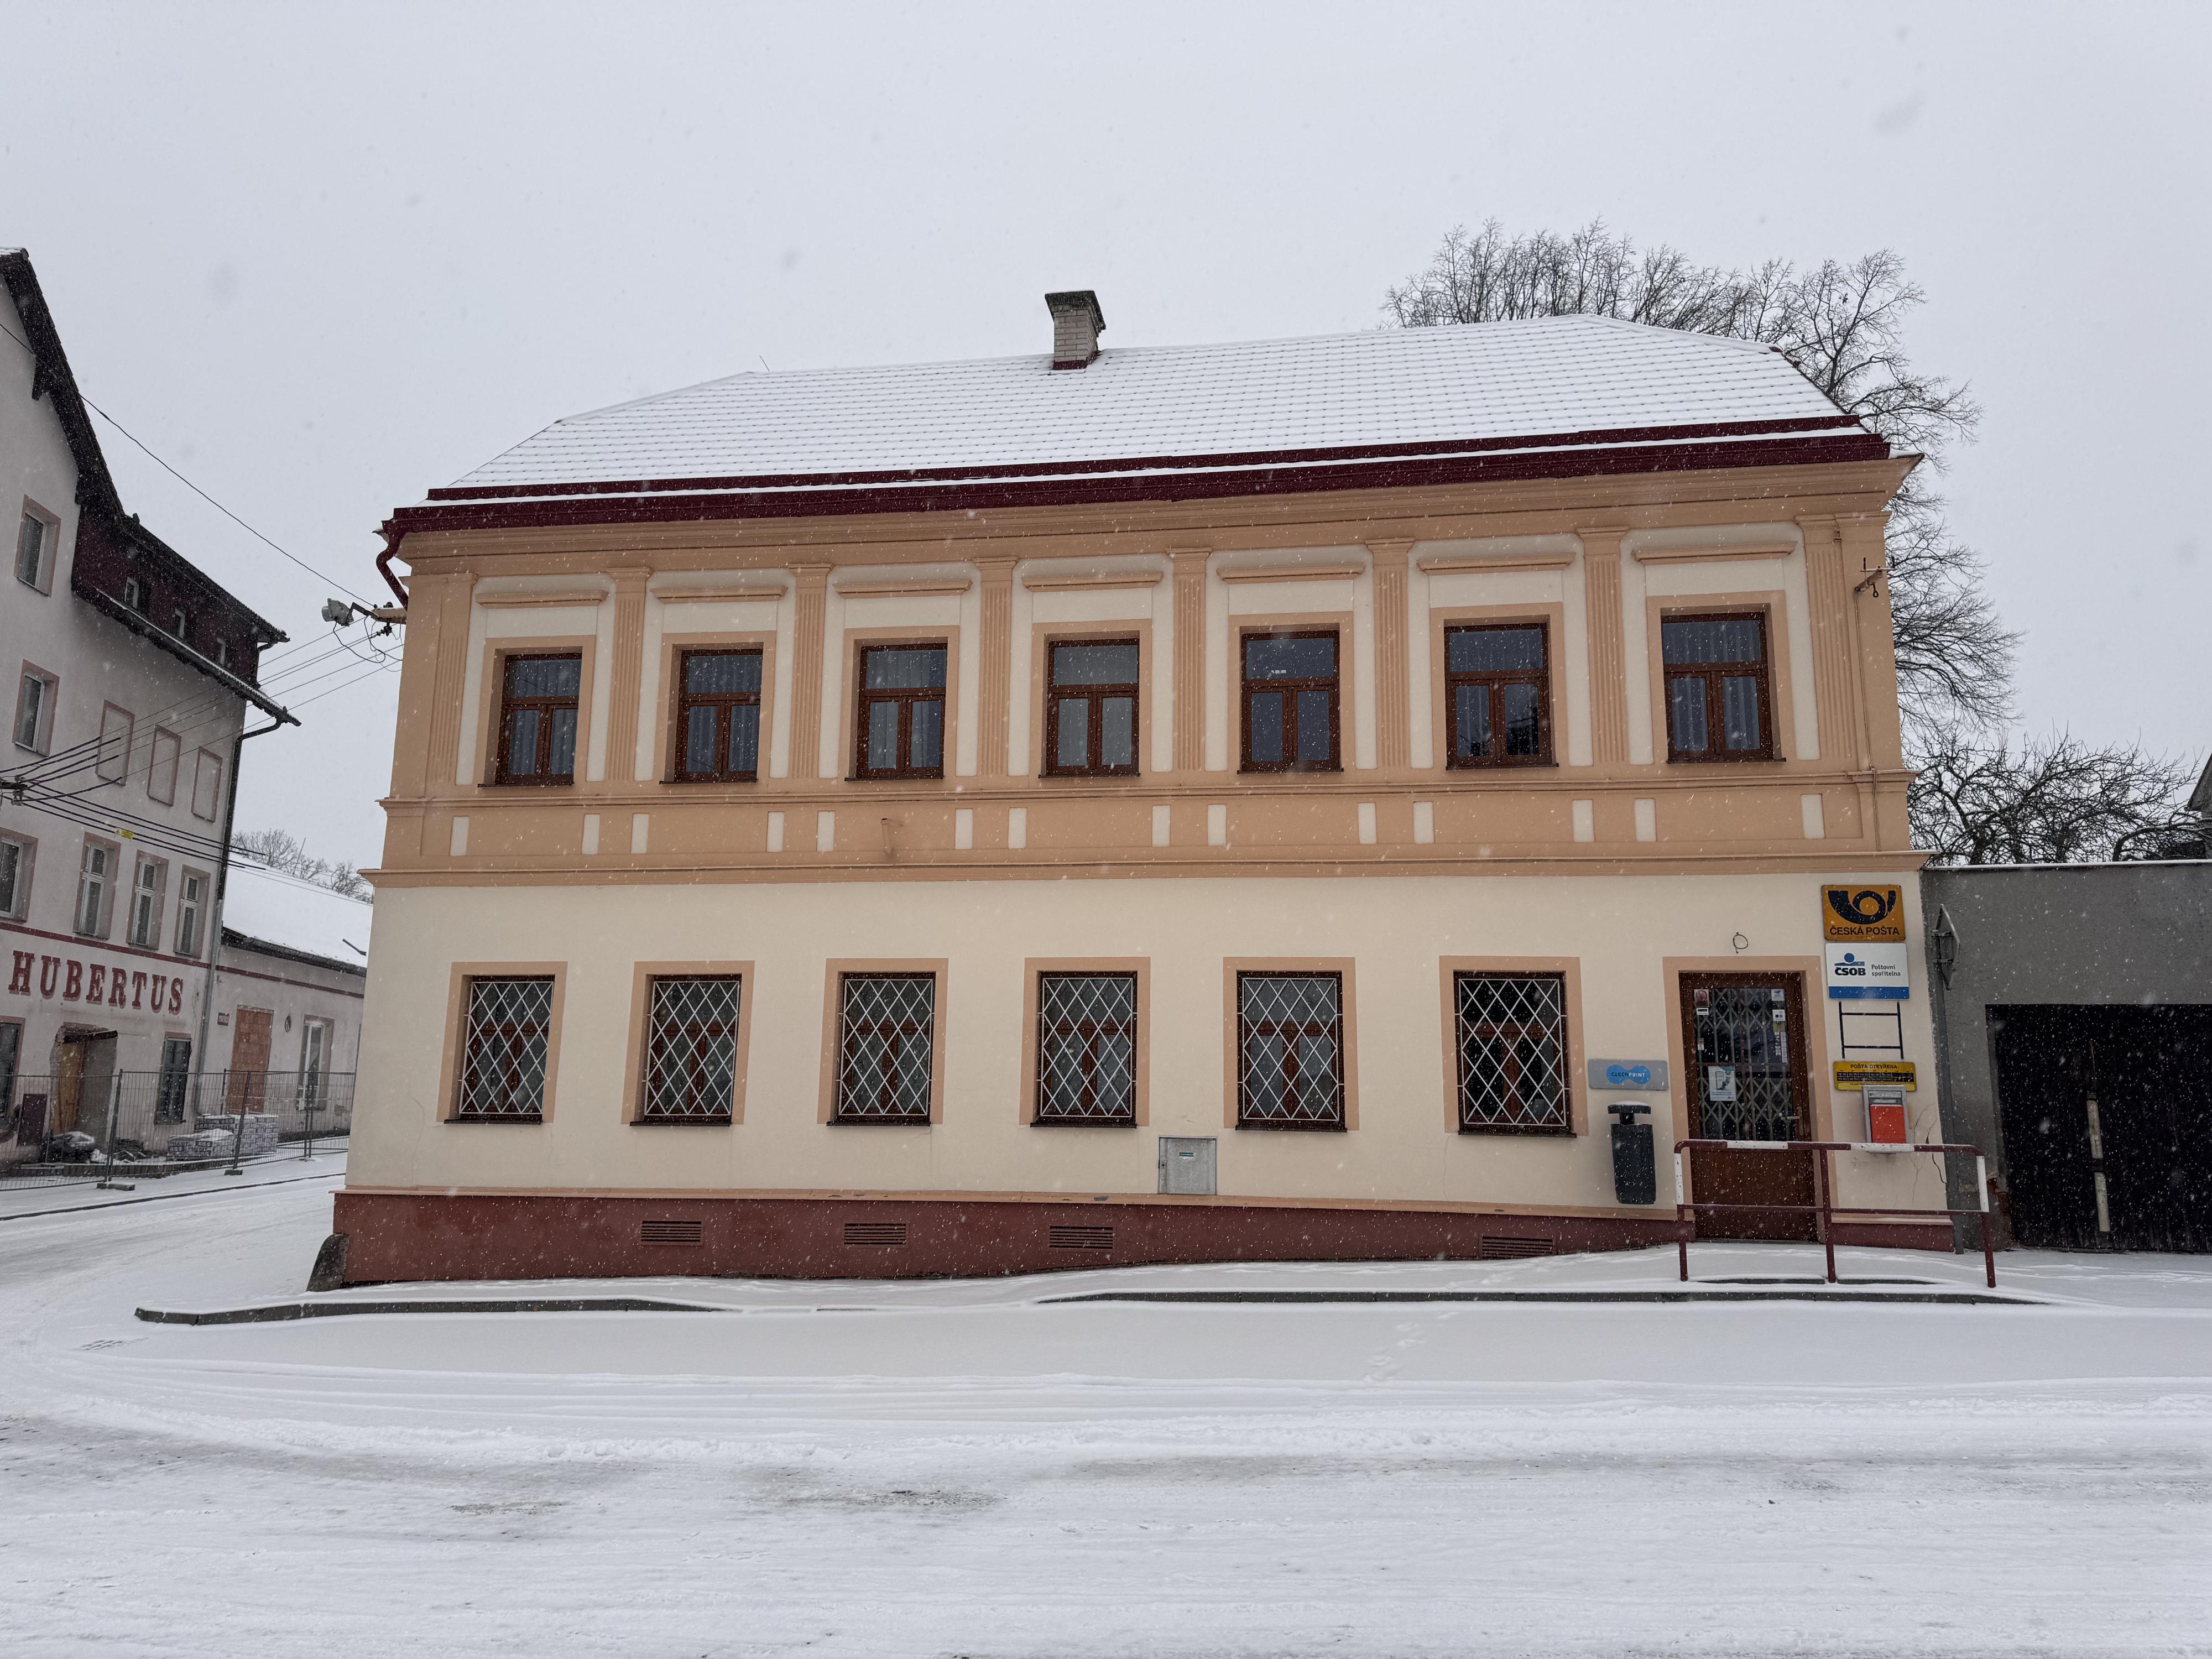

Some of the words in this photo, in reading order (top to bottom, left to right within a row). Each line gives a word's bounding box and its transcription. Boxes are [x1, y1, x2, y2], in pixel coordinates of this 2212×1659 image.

[1830, 925, 1864, 935] ČESKÁ
[1866, 925, 1900, 935] POŠTA
[1834, 967, 1866, 976] ČSOB
[8, 950, 184, 1015] HUBERTUS
